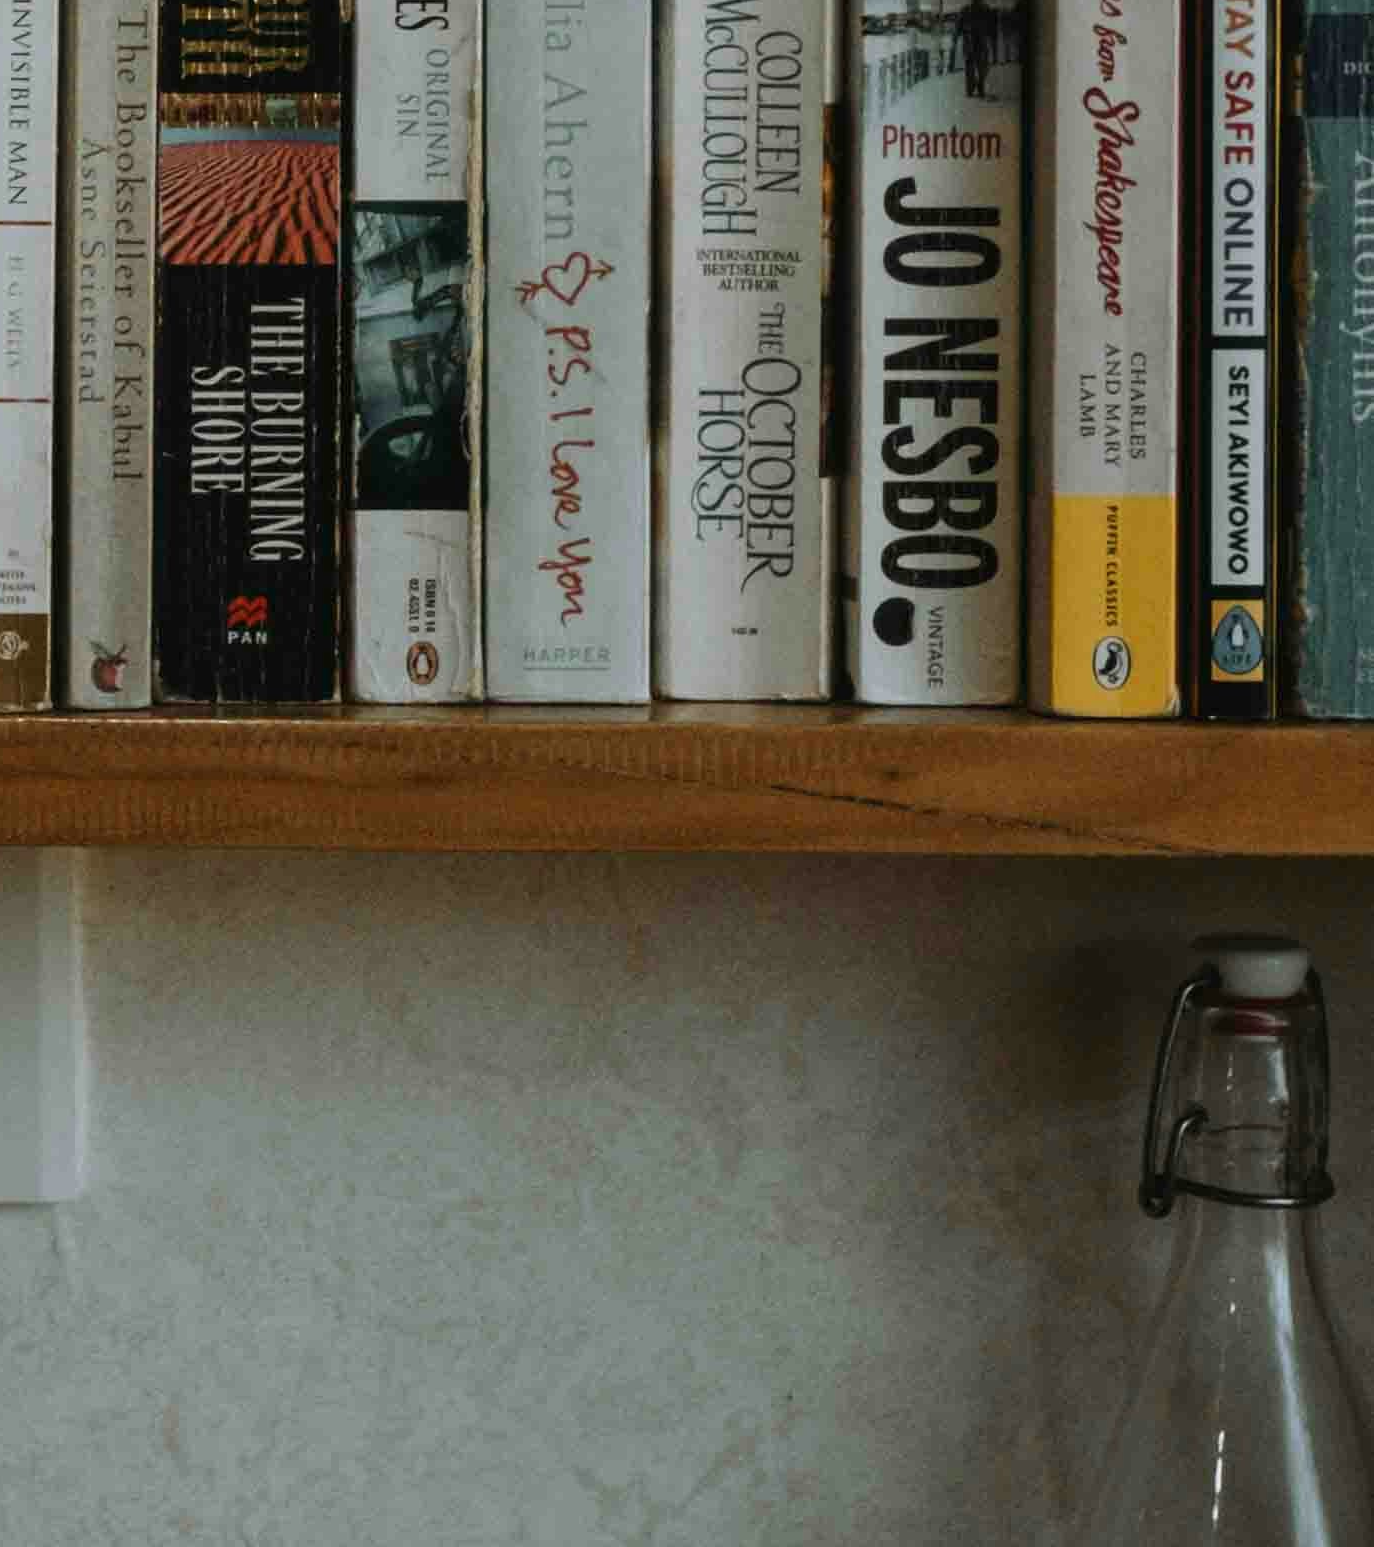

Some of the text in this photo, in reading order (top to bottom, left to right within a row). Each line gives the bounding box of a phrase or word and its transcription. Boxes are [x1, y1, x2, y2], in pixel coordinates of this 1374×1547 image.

[544, 72, 588, 241] Ahern
[1224, 71, 1254, 165] SAFE
[882, 177, 1003, 288] JO
[1222, 178, 1254, 327] ONLINE
[188, 364, 244, 494] SHORE
[246, 297, 304, 562] THE BURNING
[1079, 373, 1096, 437] LAMB
[1103, 343, 1121, 467] AND MARY
[1130, 351, 1146, 459] CHARLES
[1225, 365, 1248, 574] SEYI AKIWOWO
[1103, 505, 1119, 628] PUFFIN CLASSICS
[926, 605, 943, 688] VINTAGE
